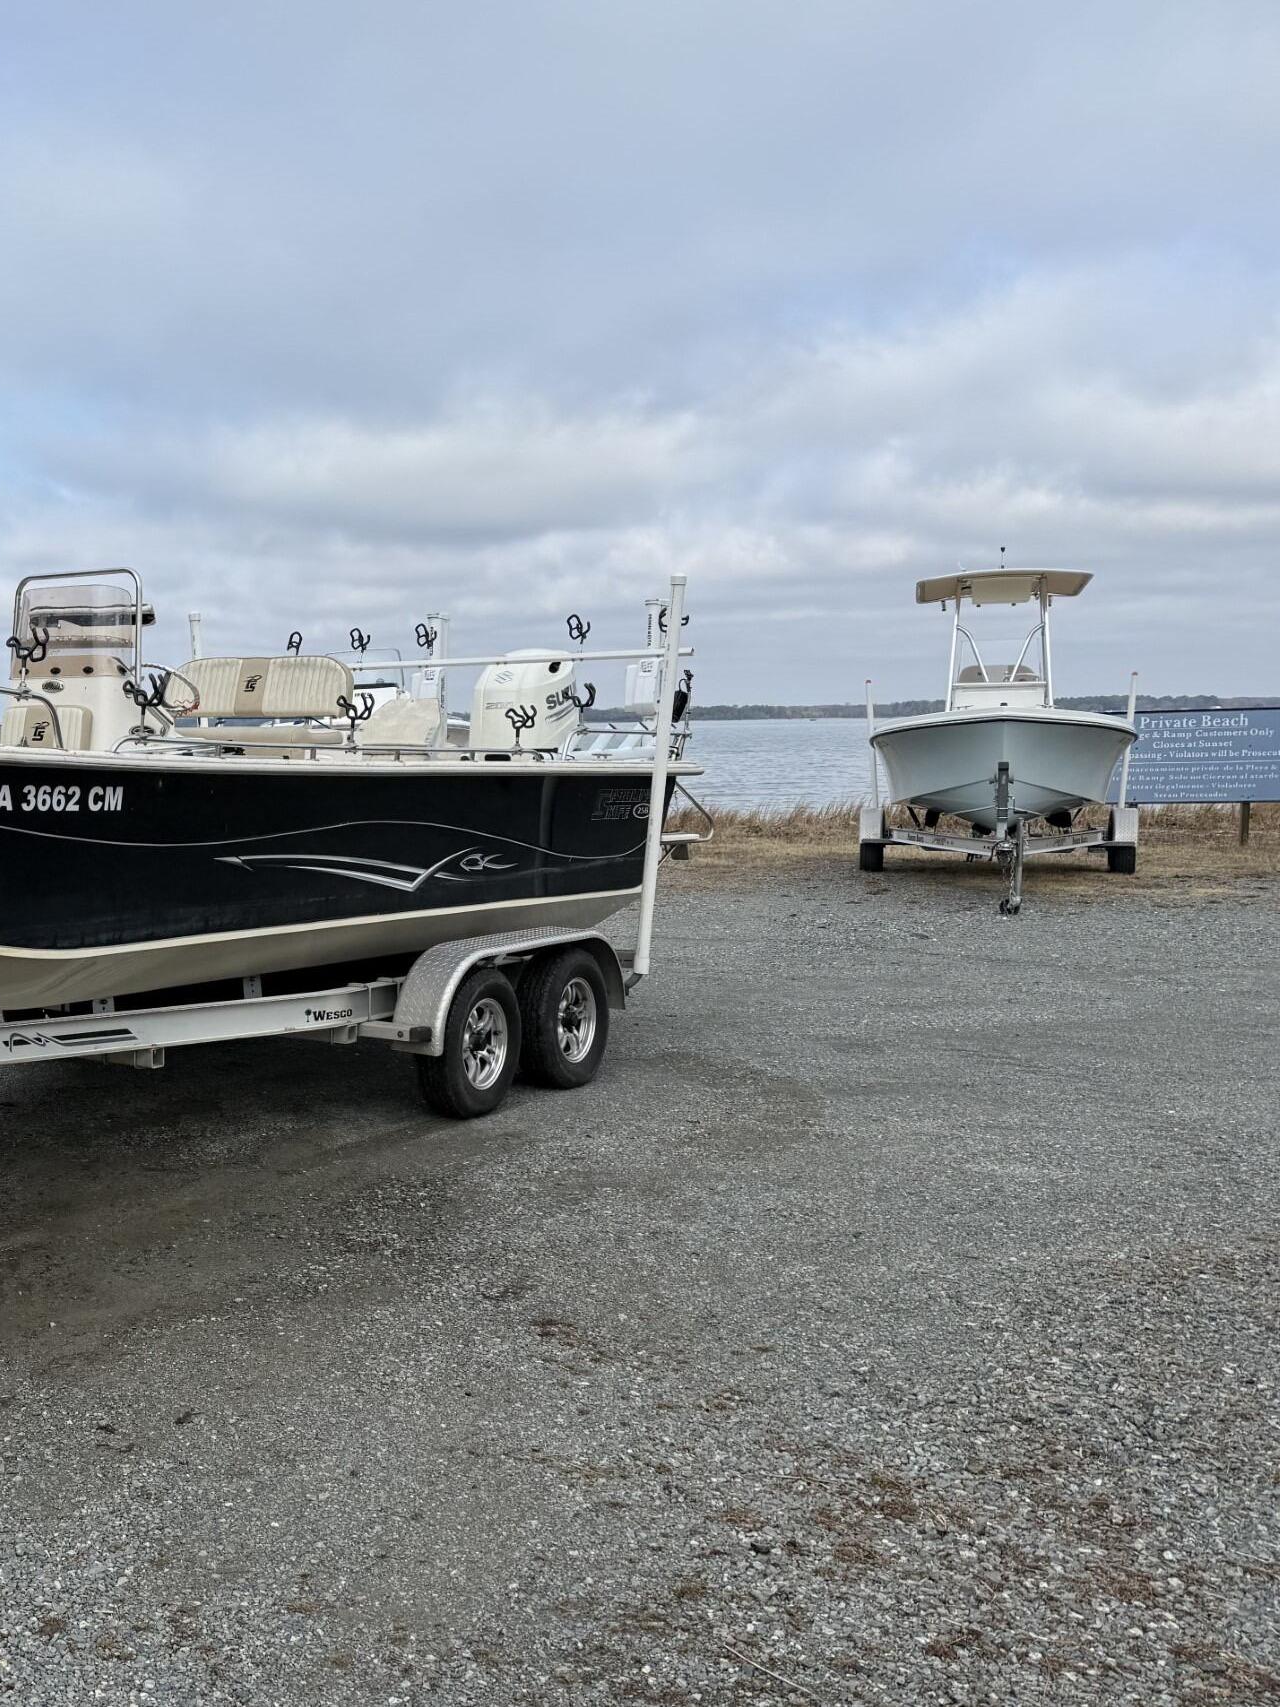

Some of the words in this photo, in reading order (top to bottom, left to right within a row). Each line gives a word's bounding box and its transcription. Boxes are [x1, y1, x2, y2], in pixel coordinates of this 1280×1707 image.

[1140, 716, 1197, 729] Private
[1201, 713, 1249, 727] Beach
[1152, 730, 1160, 738] &
[1163, 730, 1192, 739] Ramp
[1195, 729, 1248, 737] Customers
[1250, 728, 1274, 738] Only
[1153, 741, 1185, 749] Closes
[1199, 740, 1233, 748] Sunset
[1128, 751, 1162, 761] passing
[1169, 750, 1209, 758] Violators
[1211, 749, 1227, 757] will
[1229, 749, 1240, 757] be
[20, 785, 81, 812] 3662
[87, 786, 124, 812] CM
